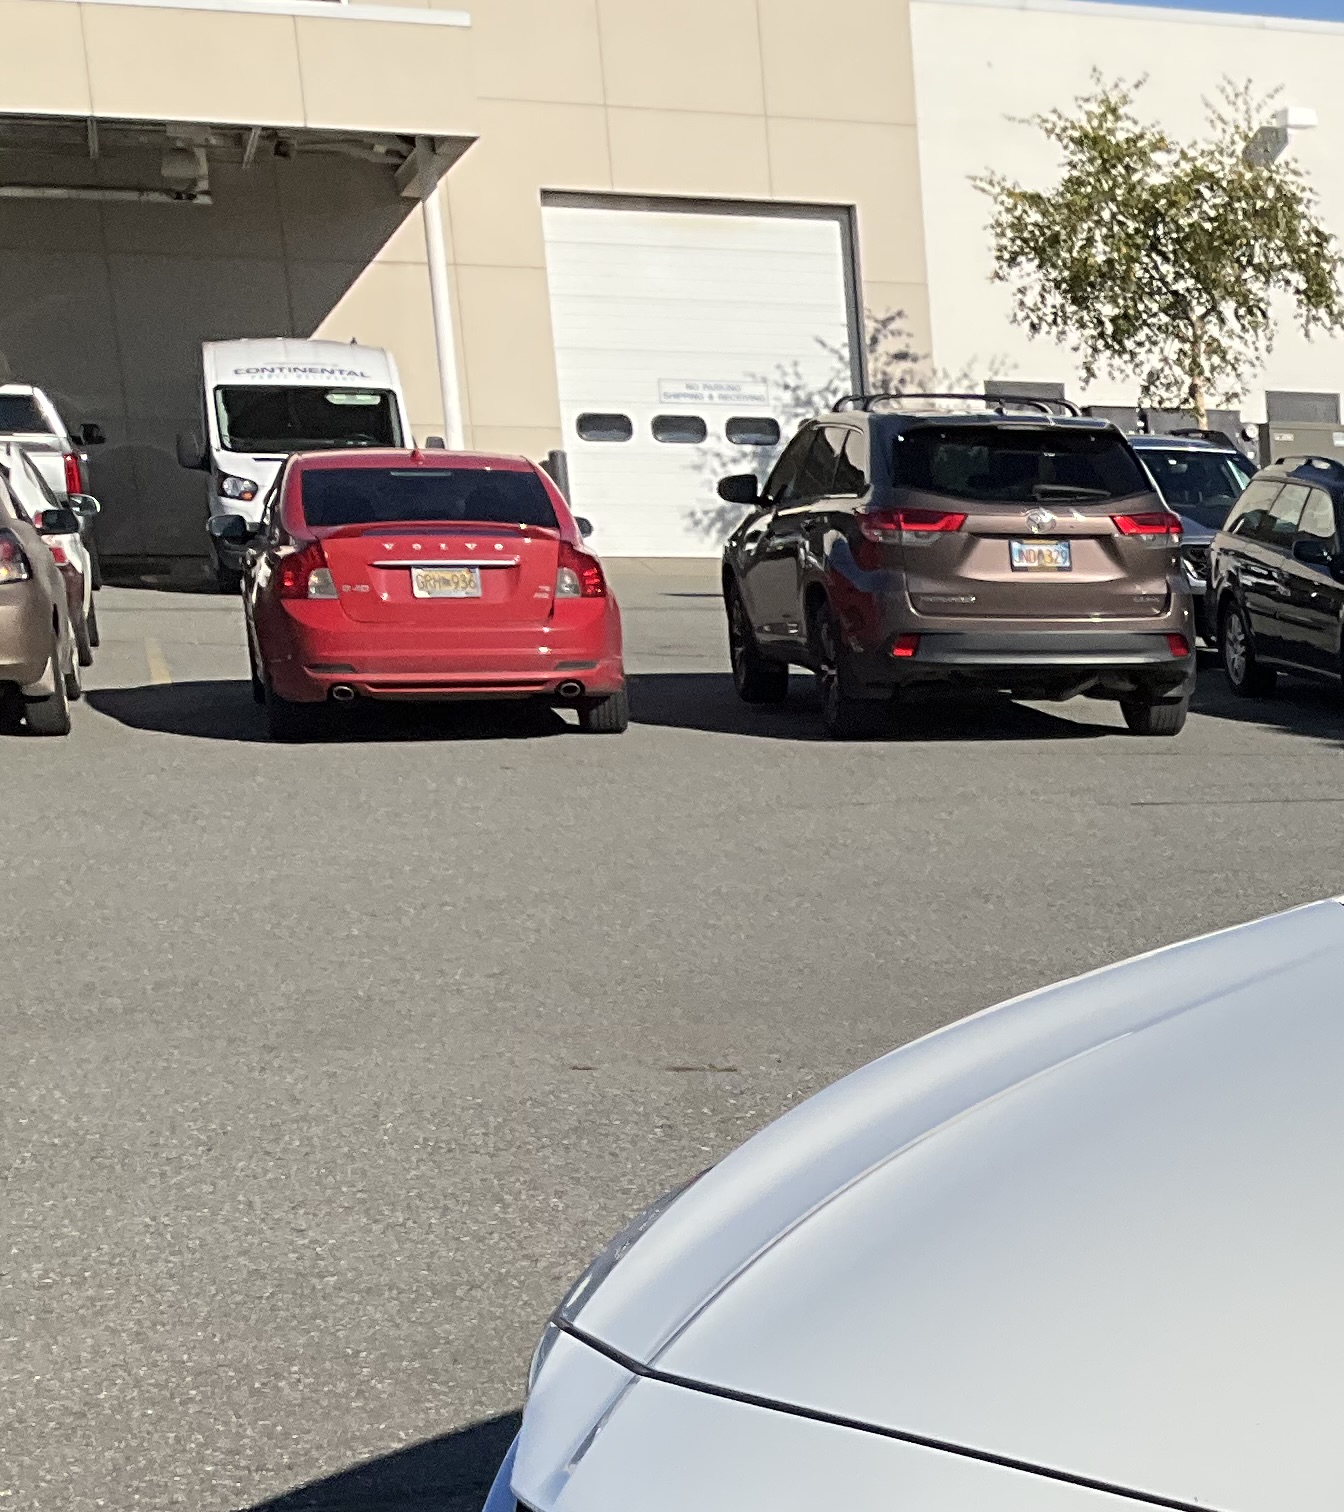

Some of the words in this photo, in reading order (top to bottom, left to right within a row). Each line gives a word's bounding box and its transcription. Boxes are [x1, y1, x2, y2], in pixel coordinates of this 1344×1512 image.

[233, 366, 372, 378] CONTINENTAL
[685, 383, 699, 391] NO
[702, 383, 742, 392] PARKING
